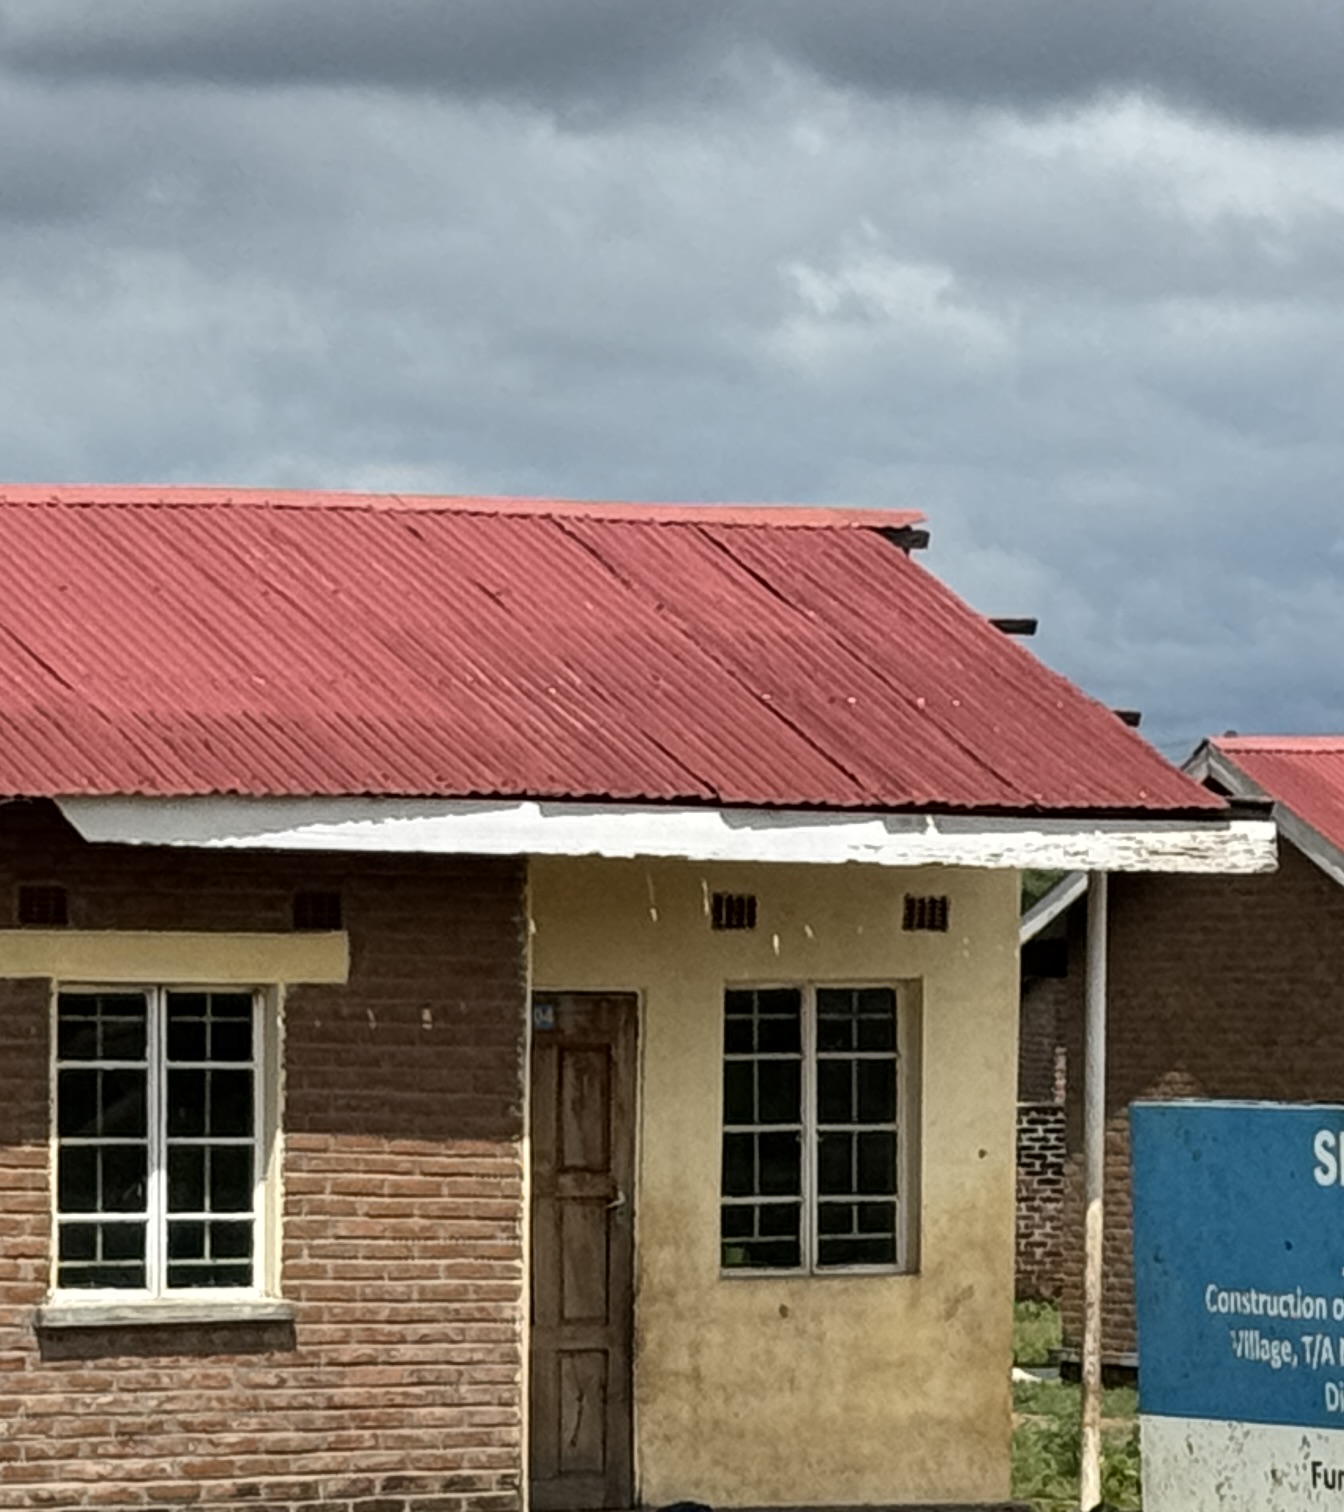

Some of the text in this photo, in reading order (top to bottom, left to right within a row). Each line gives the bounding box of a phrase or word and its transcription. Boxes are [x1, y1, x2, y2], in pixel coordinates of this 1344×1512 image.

[1205, 1283, 1327, 1321] Construction
[1229, 1329, 1298, 1370] Village,
[1301, 1333, 1335, 1371] T/A
